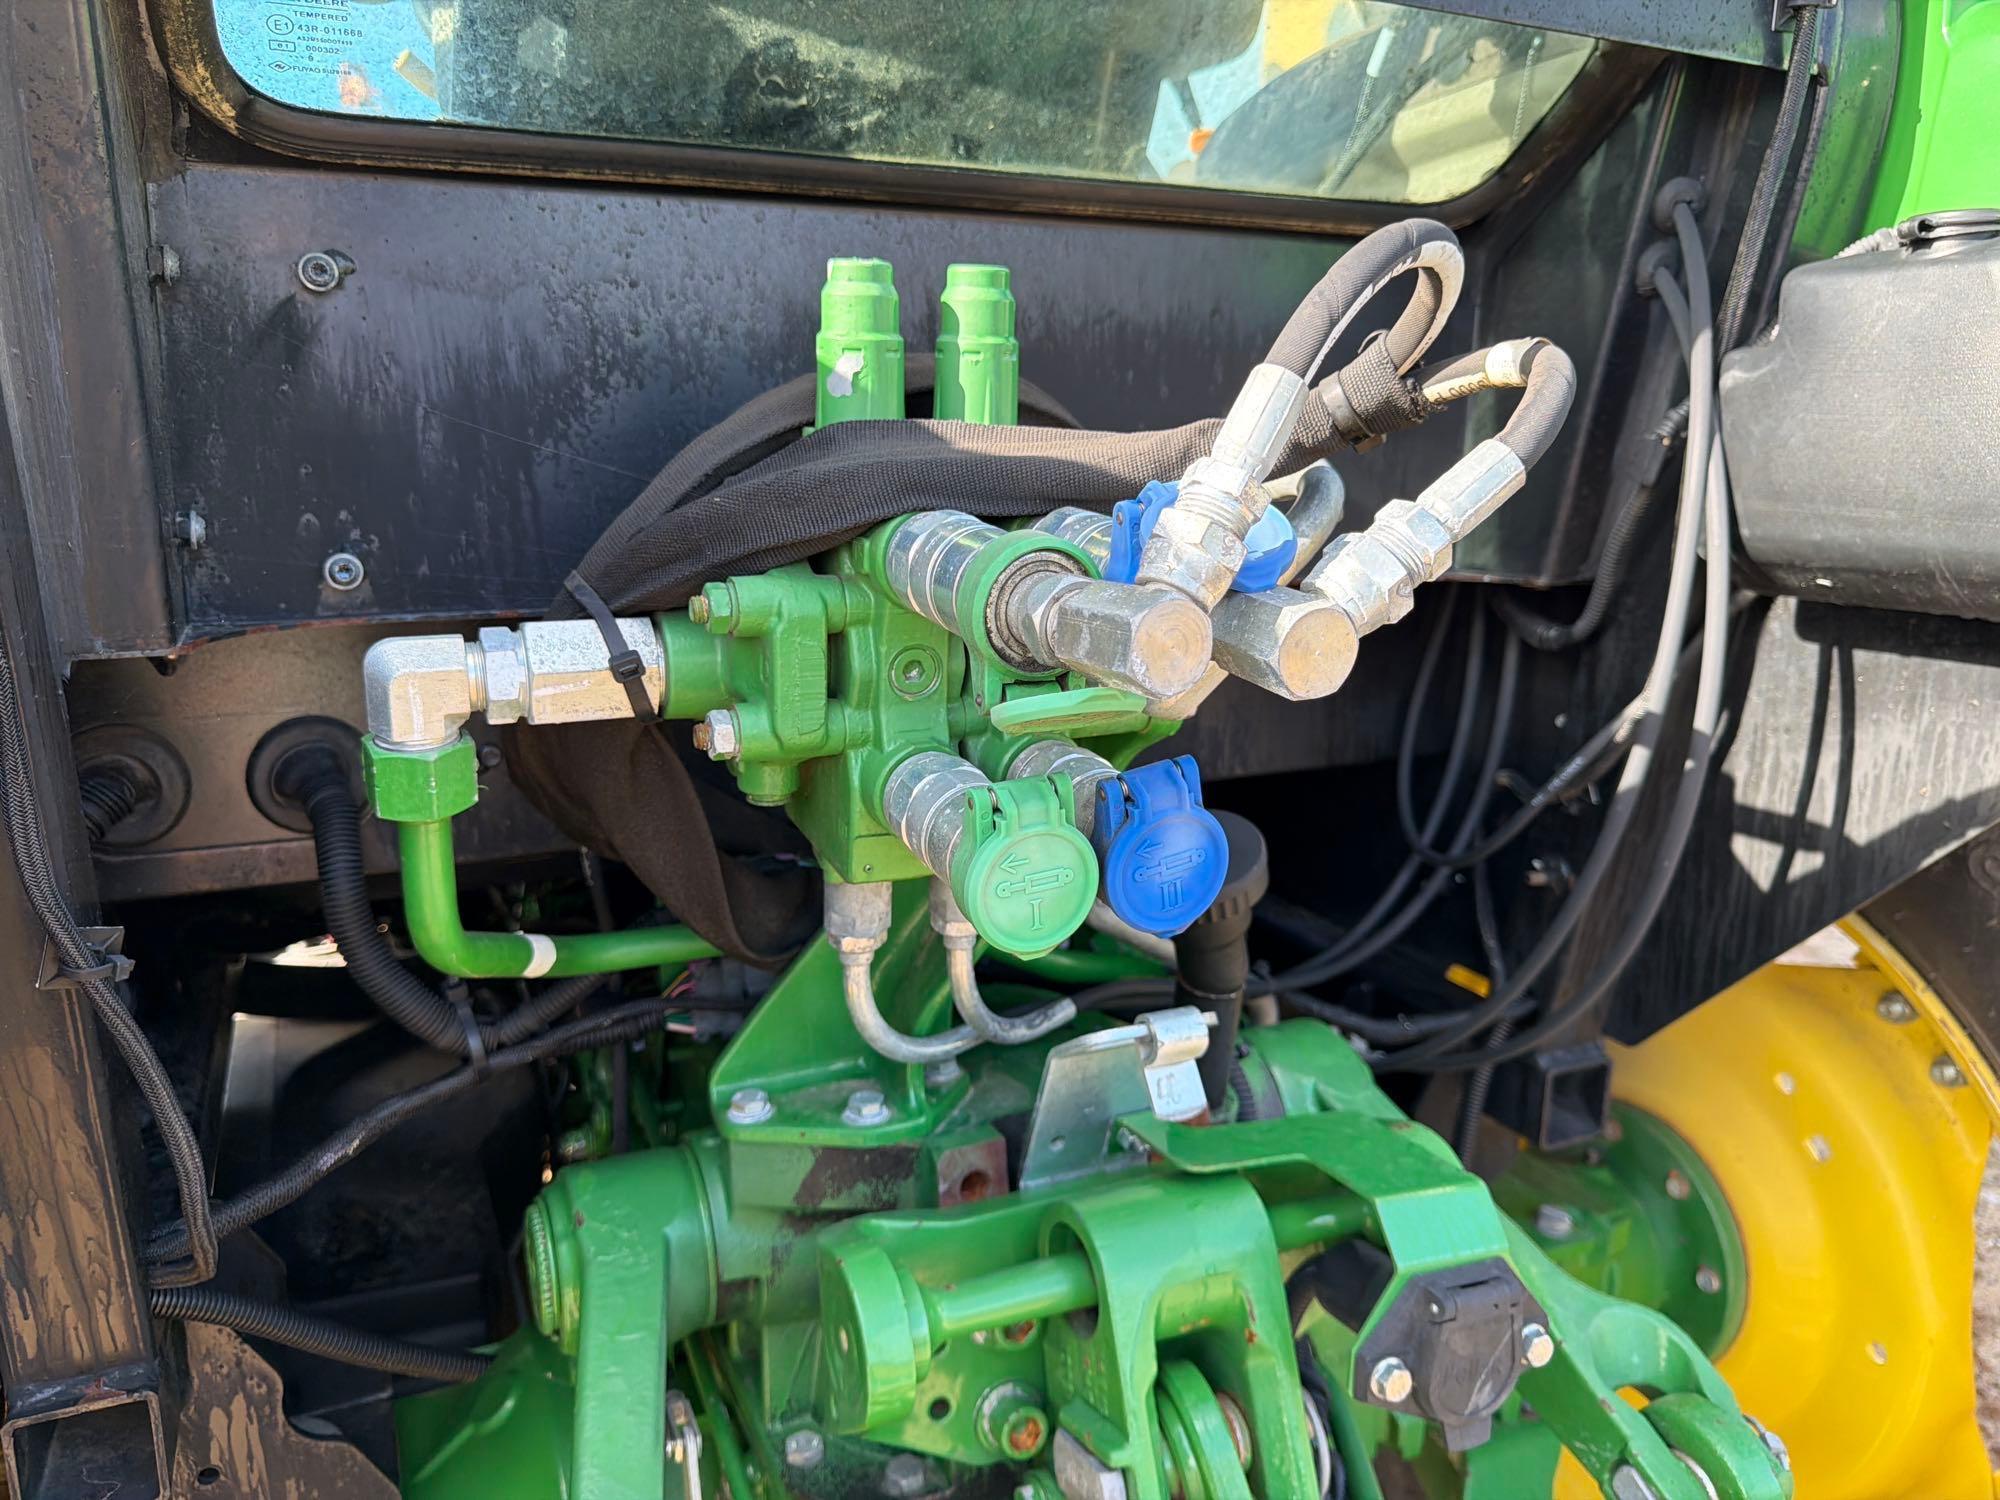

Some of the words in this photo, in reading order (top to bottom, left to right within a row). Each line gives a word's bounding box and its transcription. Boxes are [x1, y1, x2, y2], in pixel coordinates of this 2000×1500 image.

[293, 10, 348, 22] TEMPERED
[274, 19, 289, 31] E1
[305, 45, 341, 54] 000302
[292, 65, 321, 74] FUYAO
